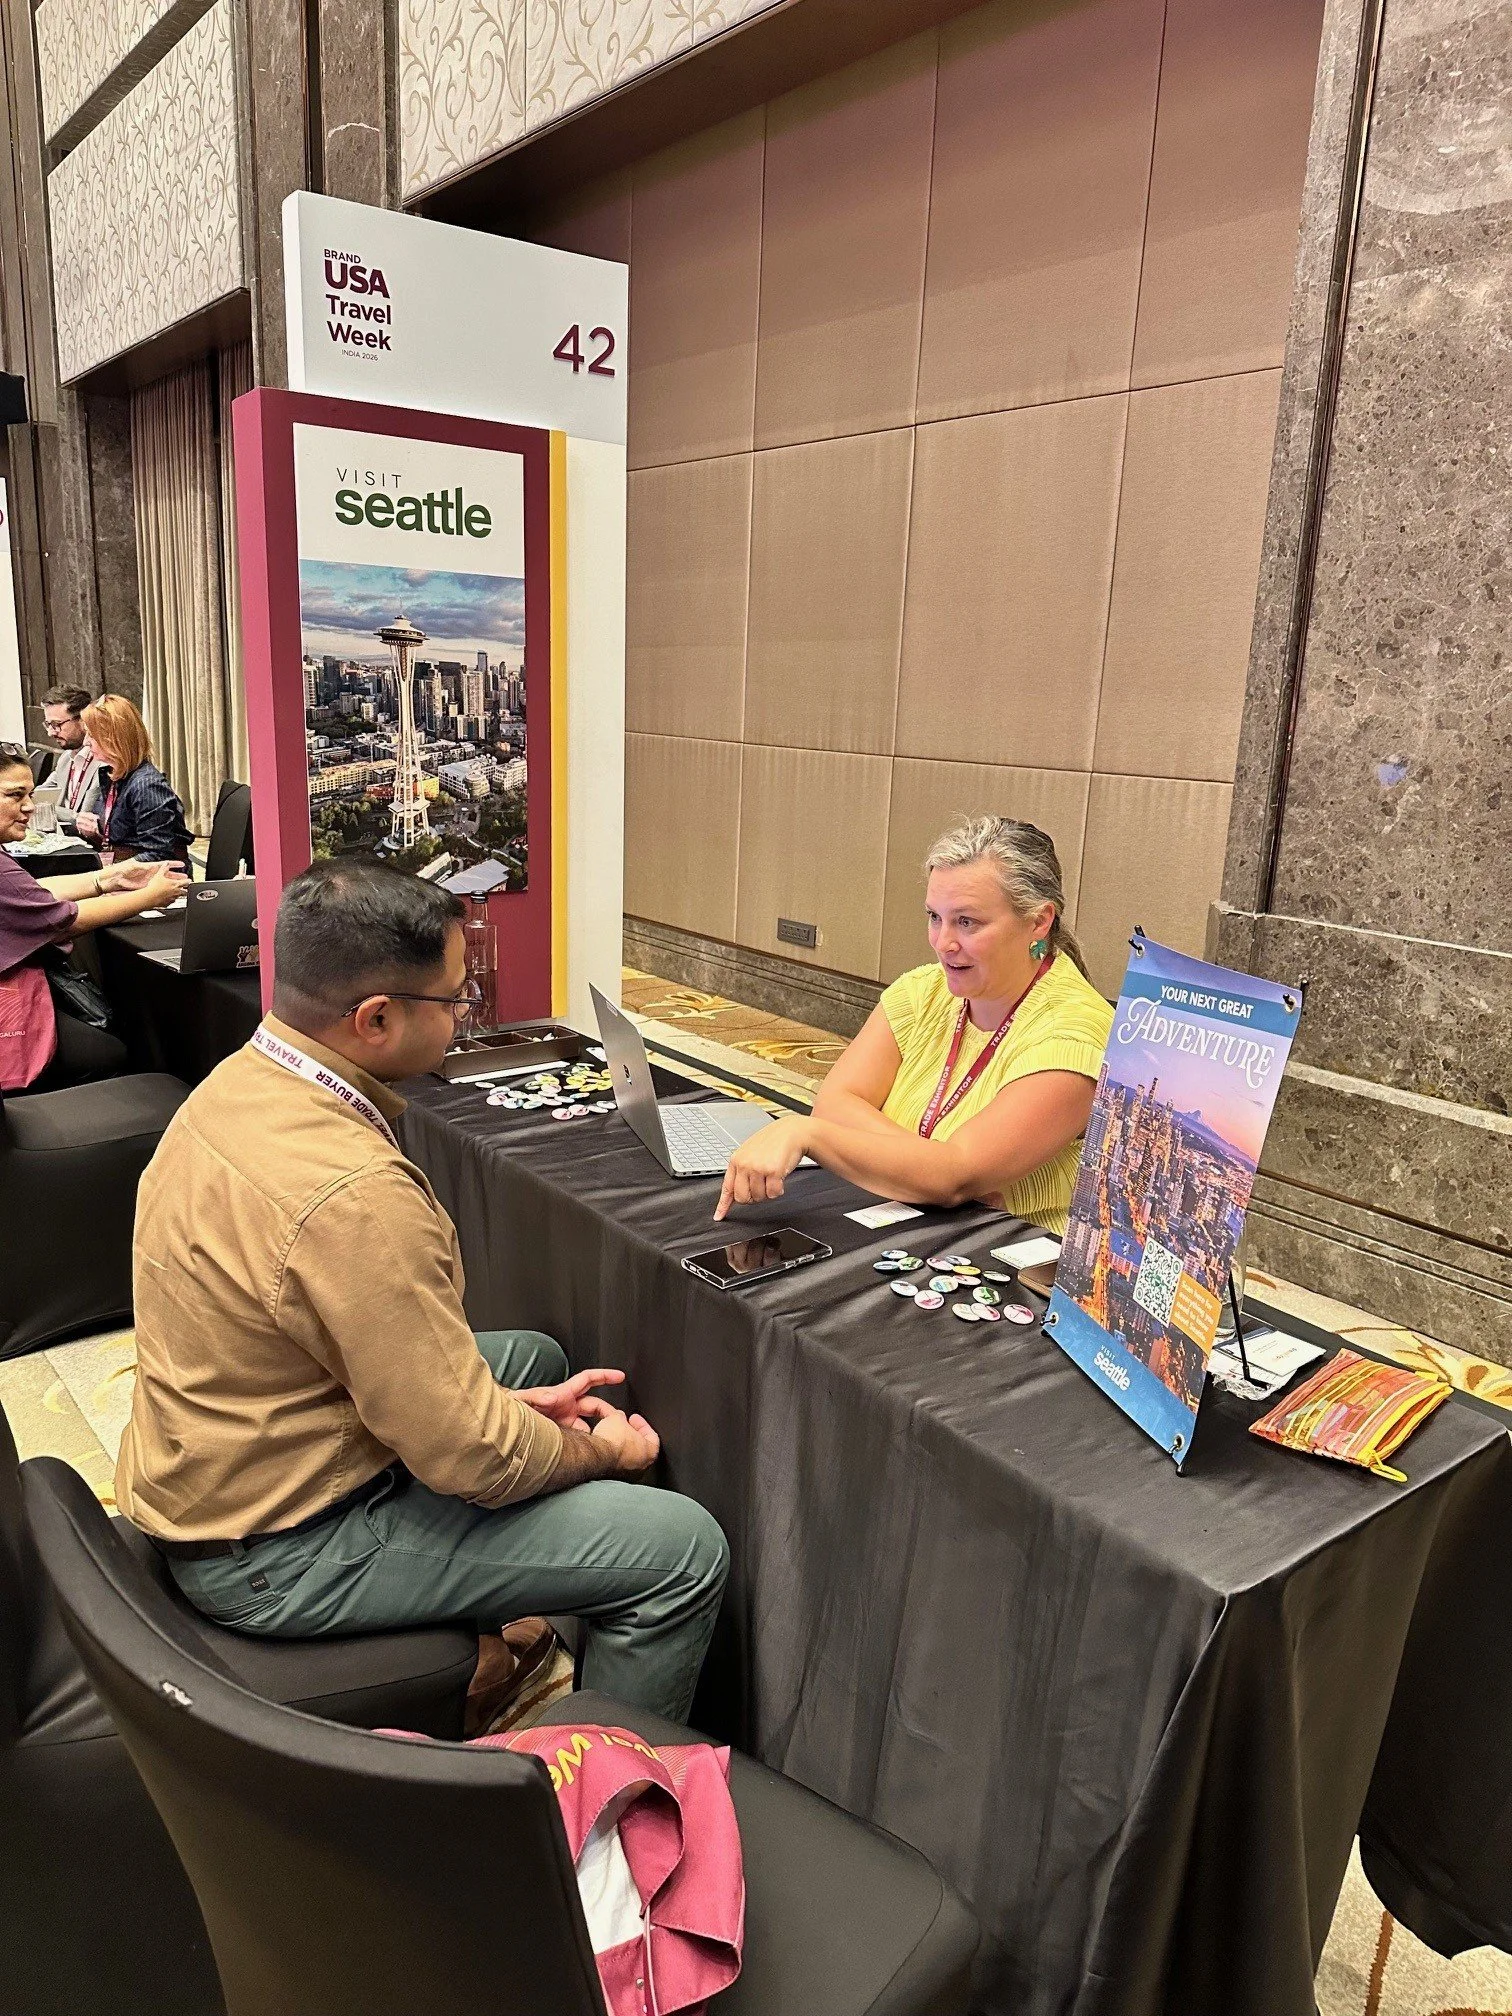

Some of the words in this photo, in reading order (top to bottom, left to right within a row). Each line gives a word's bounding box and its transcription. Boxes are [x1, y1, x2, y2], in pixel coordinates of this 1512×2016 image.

[324, 249, 361, 264] BRAND
[325, 259, 391, 299] USA
[325, 294, 392, 325] Travel
[326, 320, 392, 351] Week
[553, 324, 615, 377] 42
[342, 349, 360, 358] INDIA
[362, 352, 379, 361] 2026
[336, 467, 402, 488] VISIT
[335, 487, 492, 538] seattle
[1160, 985, 1188, 1004] YOUR
[1189, 991, 1217, 1010] NEXT
[1218, 998, 1254, 1019] GREAT
[990, 1020, 1011, 1047] TRADE
[1117, 996, 1275, 1089] ADVENTURE
[266, 1039, 303, 1069] TRAVEL
[316, 1070, 353, 1101] BUYER
[920, 1109, 934, 1137] TRADE
[930, 1065, 951, 1109] EXHIBITOR
[941, 1076, 973, 1116] EXHIBITOR
[351, 1097, 378, 1122] TRADE
[1101, 1344, 1116, 1361] VISIT
[1093, 1351, 1131, 1391] seattle
